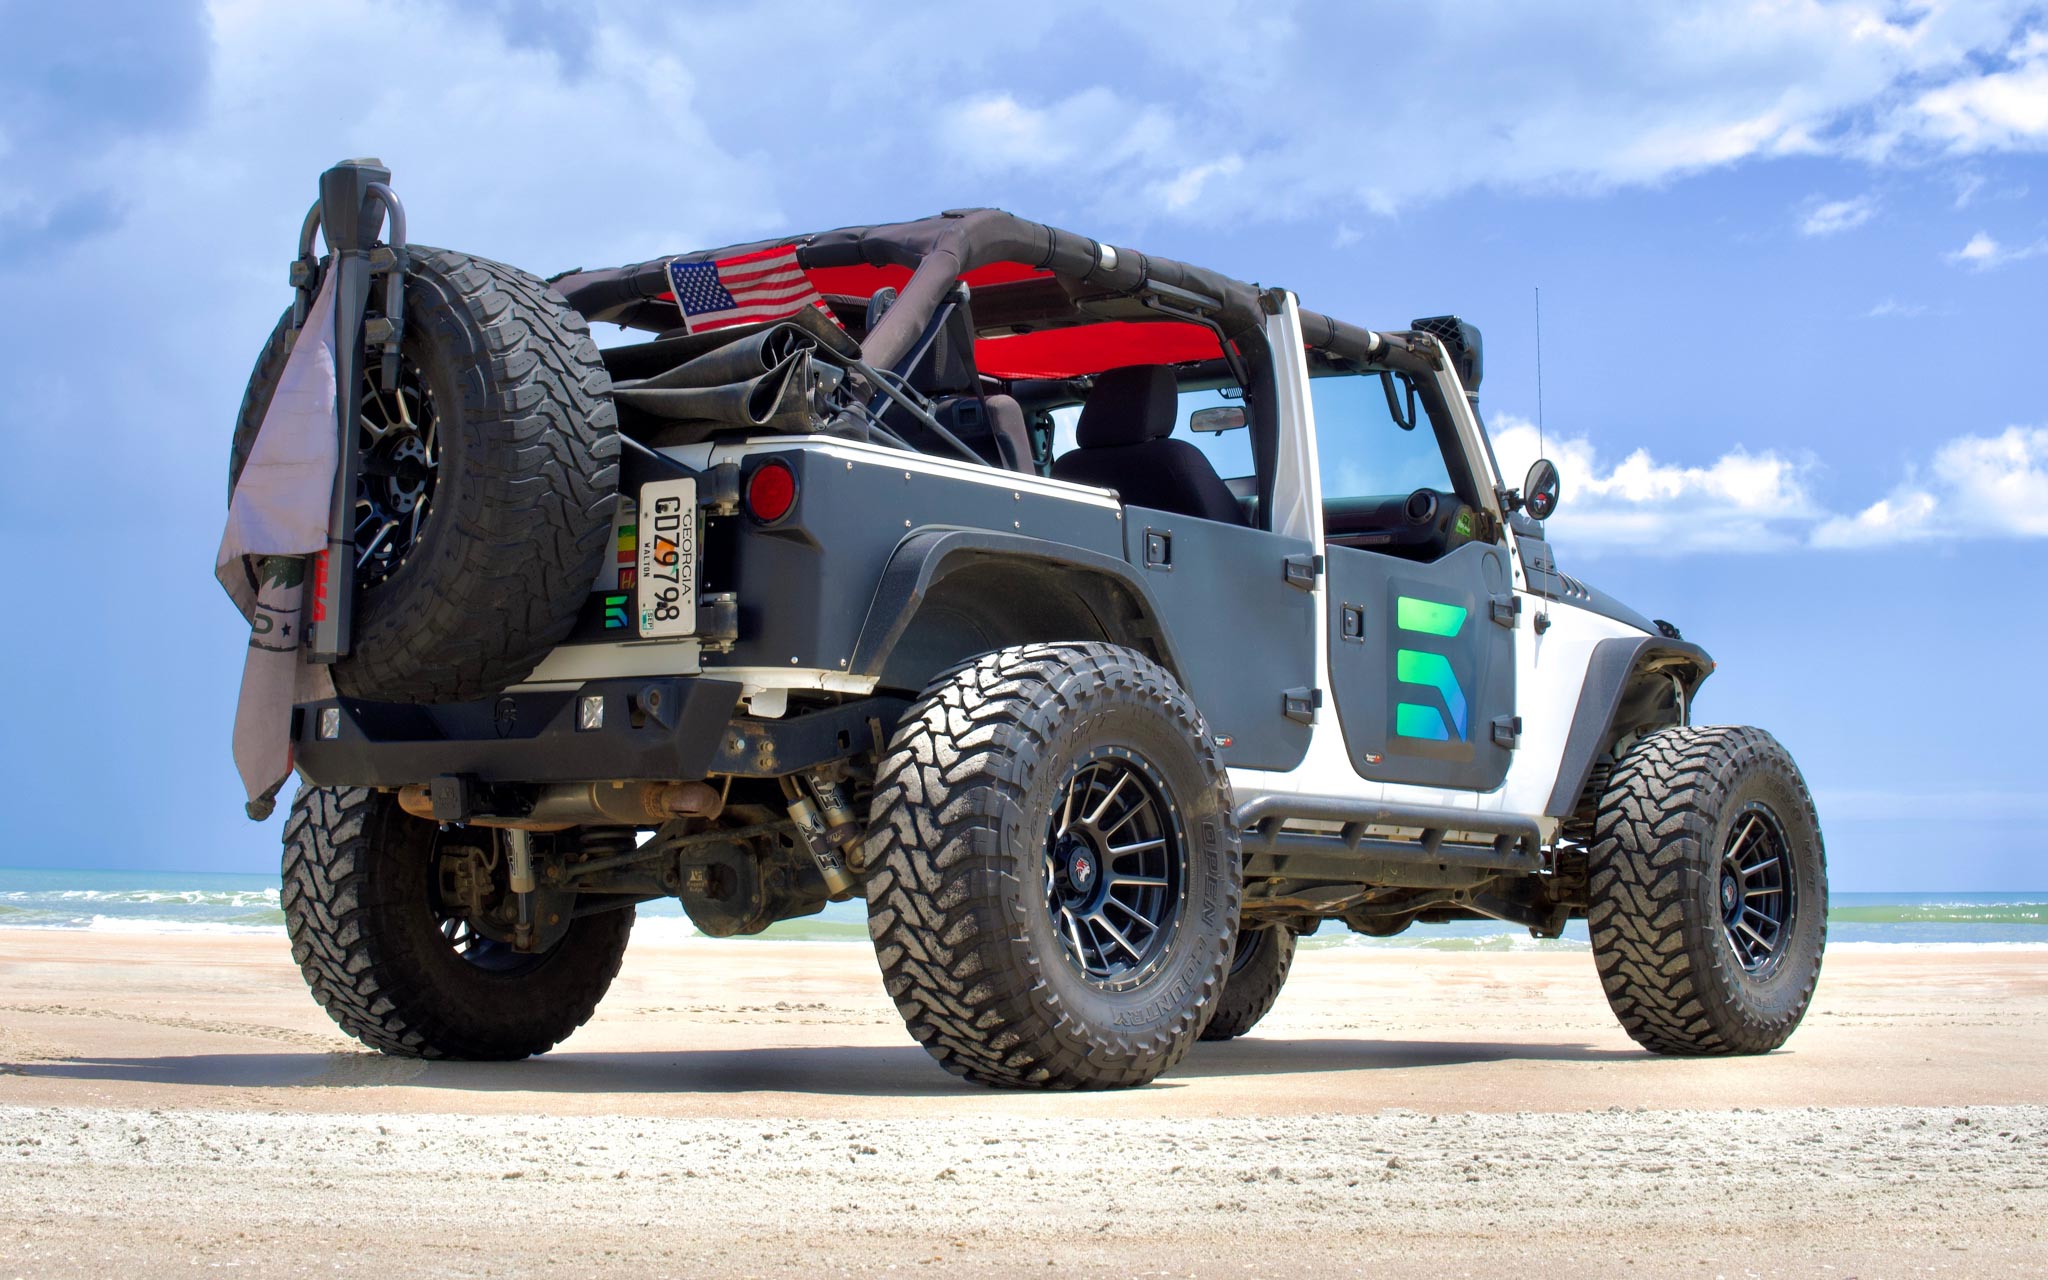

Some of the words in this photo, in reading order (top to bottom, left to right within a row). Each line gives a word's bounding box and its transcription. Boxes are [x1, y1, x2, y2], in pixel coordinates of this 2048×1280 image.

[643, 542, 651, 578] WALTON
[681, 513, 692, 596] GEORGIA
[1200, 820, 1219, 929] OPEN
[1113, 933, 1208, 1027] COUNTRY
